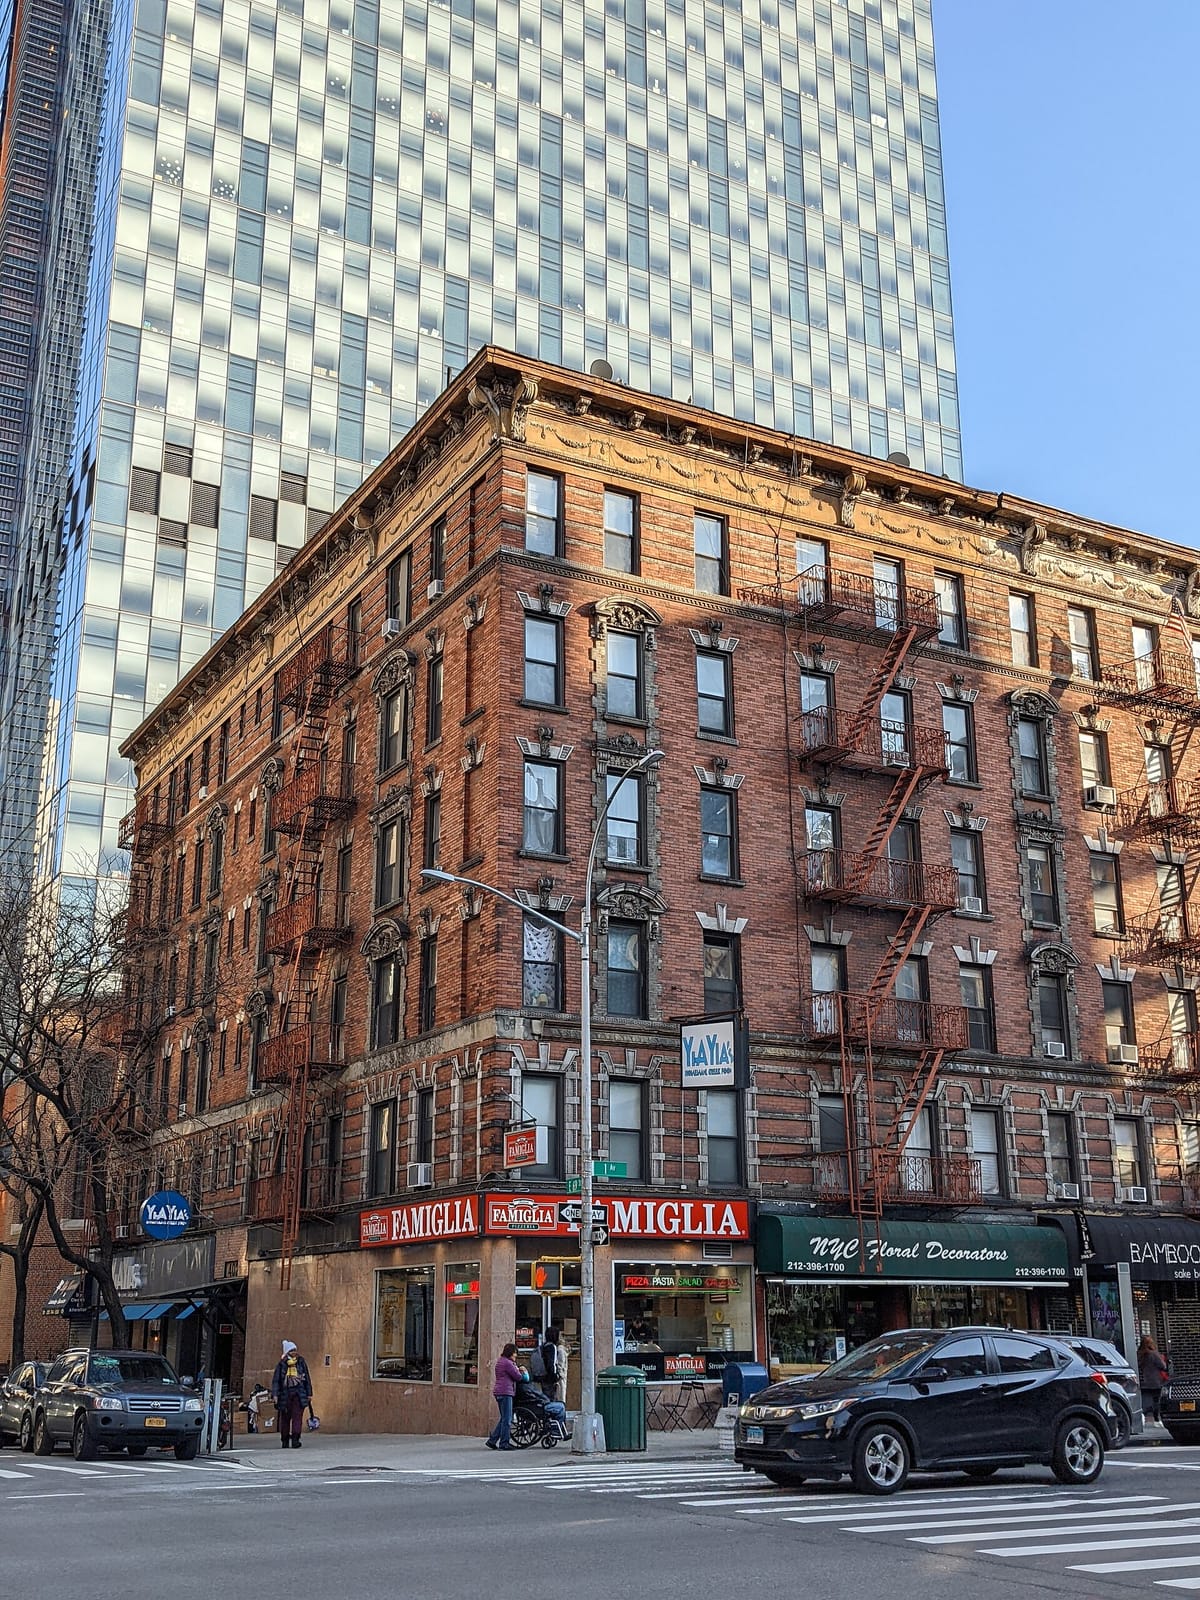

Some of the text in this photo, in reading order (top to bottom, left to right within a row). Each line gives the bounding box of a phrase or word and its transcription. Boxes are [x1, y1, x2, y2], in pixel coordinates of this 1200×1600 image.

[509, 1142, 534, 1158] FAMIGLIA
[604, 1163, 607, 1175] 1
[391, 1198, 475, 1240] FAMIGLIA
[493, 1208, 553, 1223] FAMIGLIA
[565, 1209, 580, 1219] ONE
[809, 1236, 1009, 1261] NYC Floral Decorators
[1130, 1242, 1200, 1264] BAMBOO
[787, 1261, 845, 1272] 212-396-1700
[1015, 1267, 1066, 1276] 212-396-1700
[1174, 1268, 1200, 1279] sake b
[626, 1276, 649, 1286] PIZZA
[652, 1276, 675, 1286] PASTA
[678, 1277, 703, 1287] SALAD
[615, 1339, 623, 1350] A
[666, 1360, 704, 1370] FAMIGLIA
